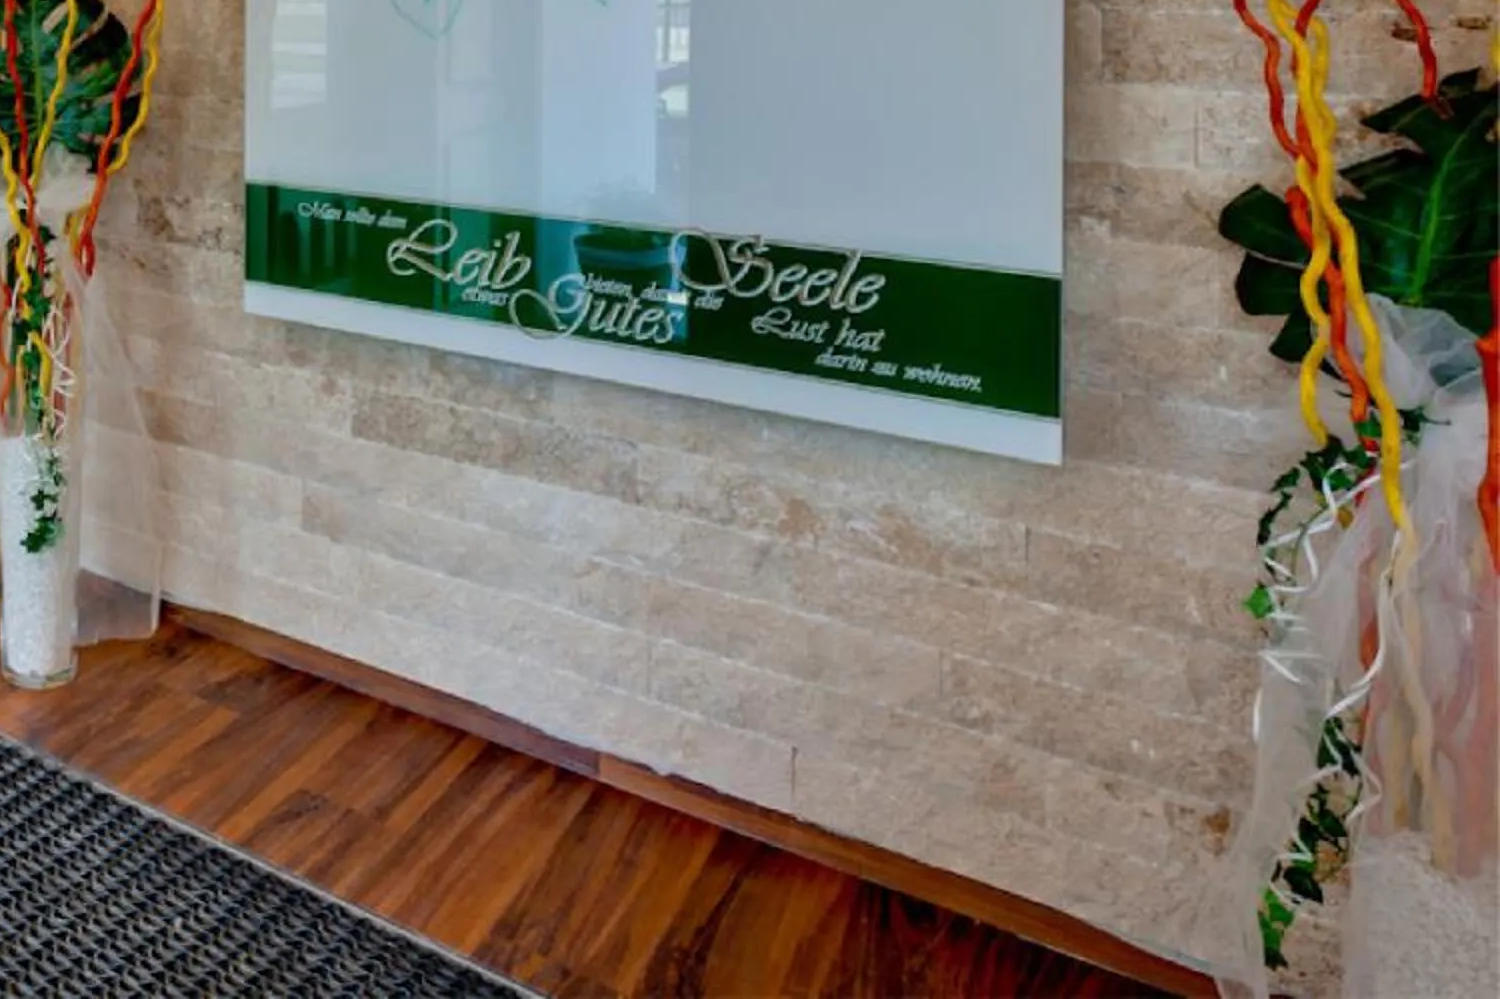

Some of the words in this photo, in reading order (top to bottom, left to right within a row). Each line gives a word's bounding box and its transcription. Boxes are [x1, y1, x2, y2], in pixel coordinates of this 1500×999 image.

[387, 219, 532, 289] Leib
[668, 230, 885, 313] Seele
[508, 273, 684, 344] Gutes
[751, 307, 830, 344] Lust
[835, 317, 886, 352] hat
